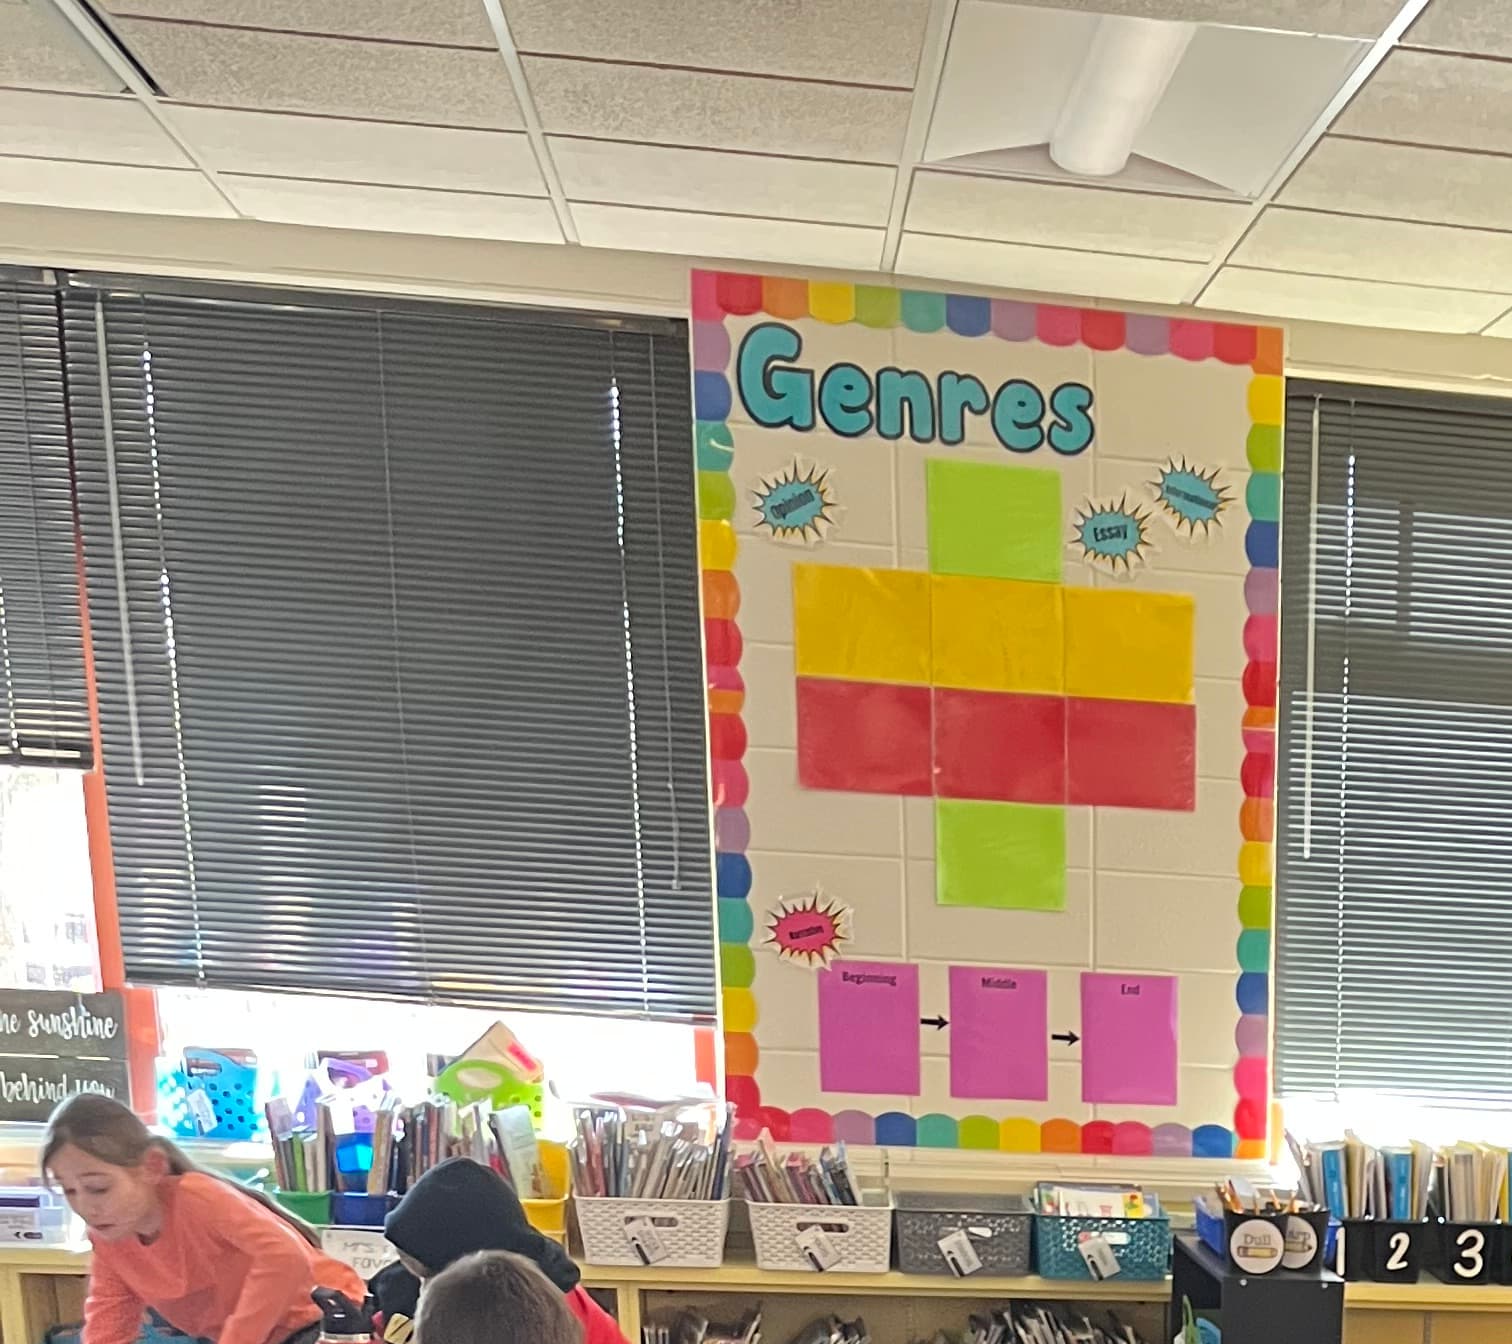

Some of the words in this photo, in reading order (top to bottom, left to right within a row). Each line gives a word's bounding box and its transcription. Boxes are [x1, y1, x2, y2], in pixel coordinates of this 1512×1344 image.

[737, 321, 1094, 456] Genres
[1093, 523, 1128, 543] Essay
[981, 977, 1017, 990] Middle
[1120, 983, 1140, 996] End
[27, 1006, 118, 1040] sunshine
[0, 1071, 68, 1104] behind
[1243, 1233, 1272, 1246] Dull
[1335, 1226, 1345, 1276] 1
[1386, 1231, 1411, 1271] 2
[1453, 1229, 1485, 1278] 3
